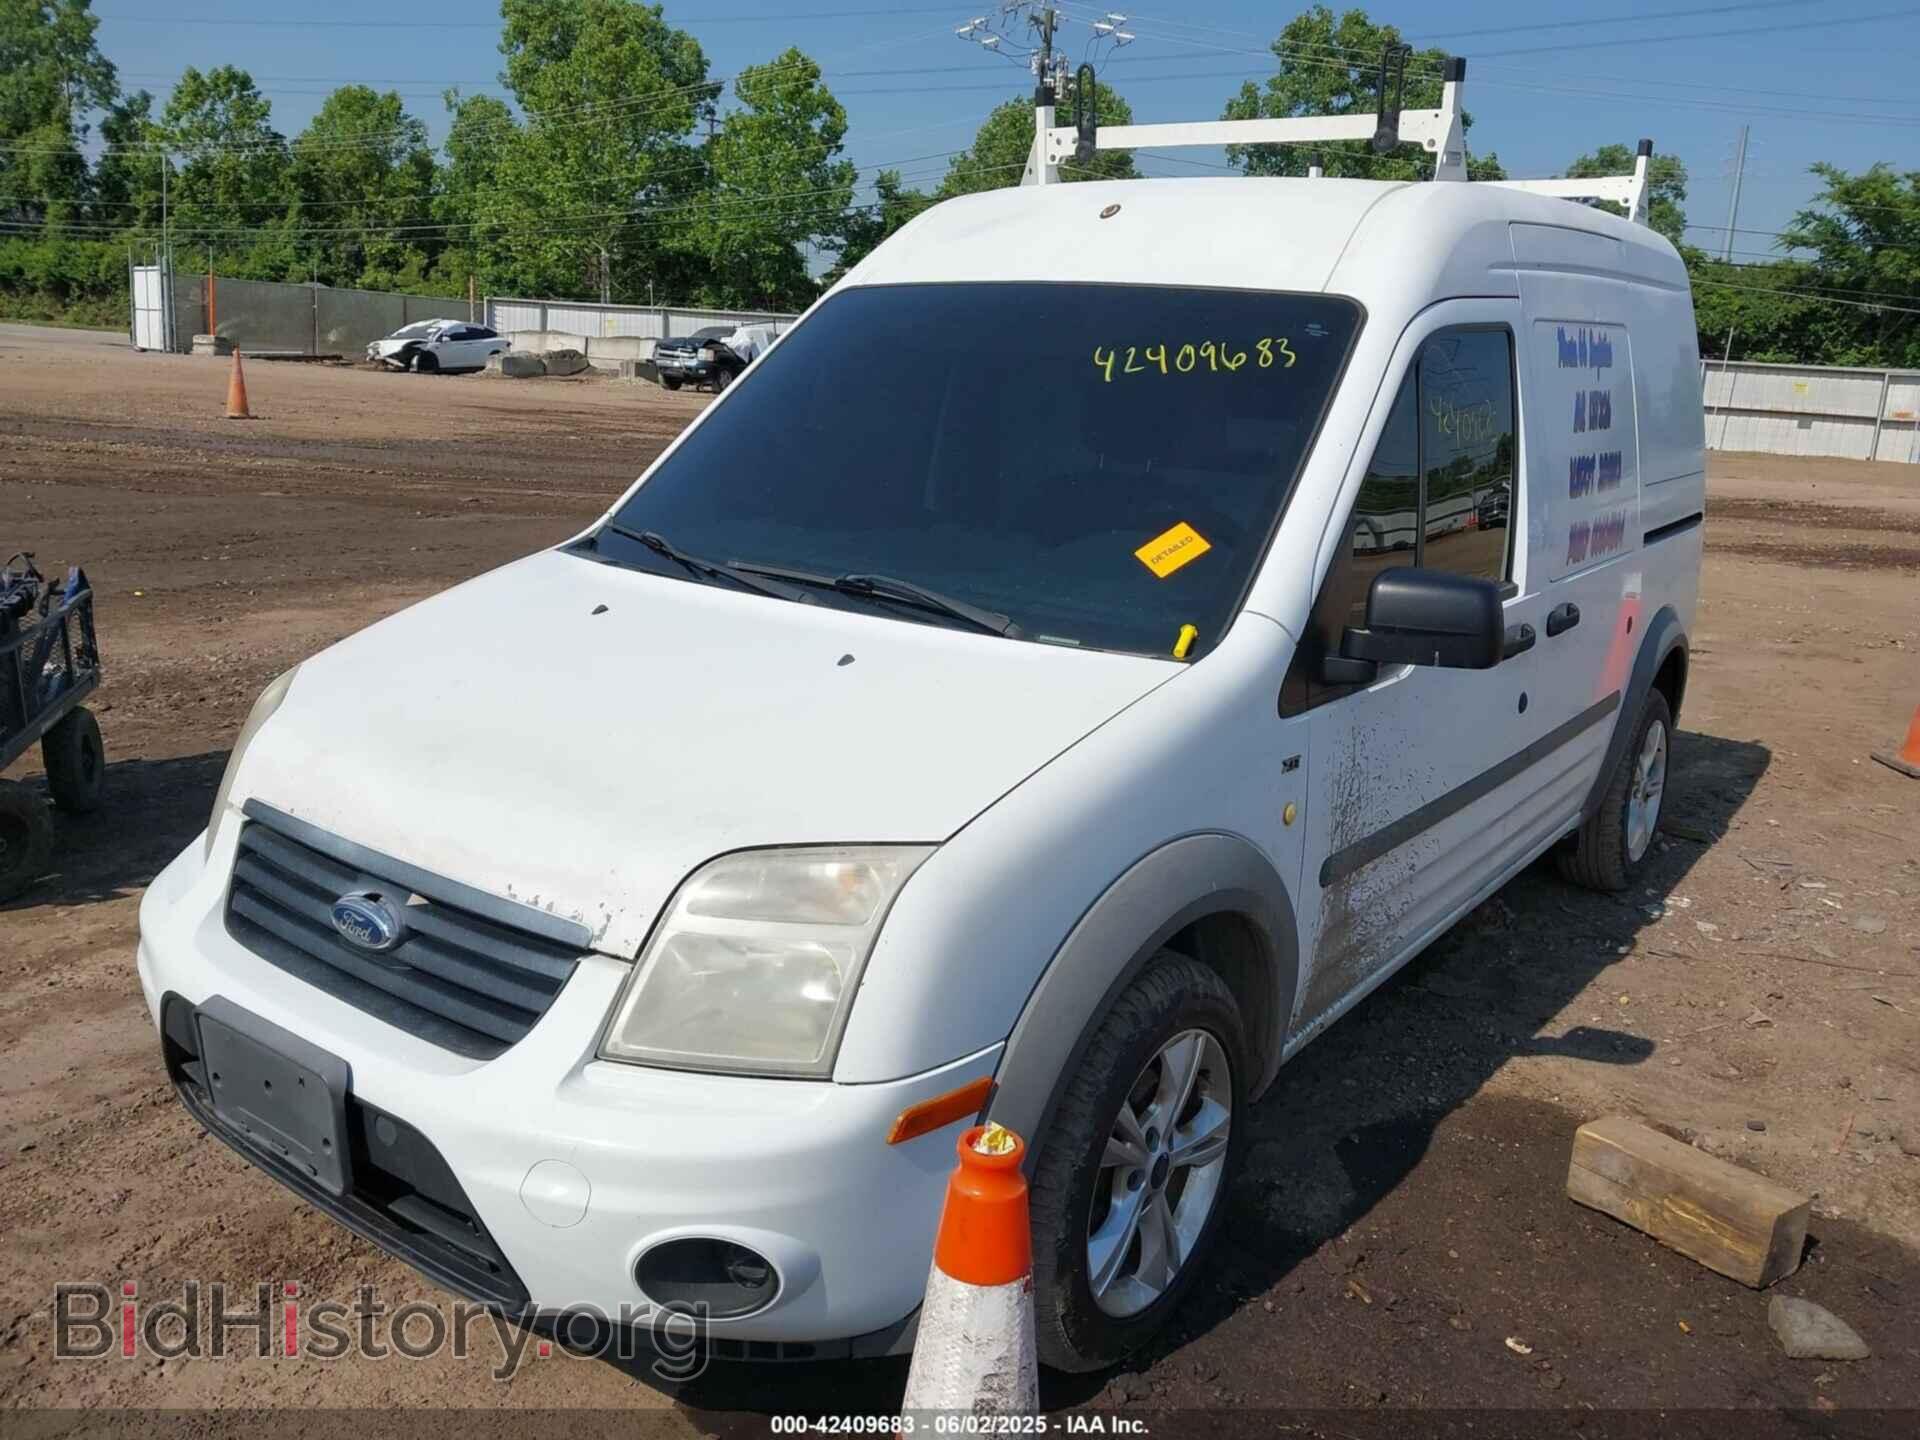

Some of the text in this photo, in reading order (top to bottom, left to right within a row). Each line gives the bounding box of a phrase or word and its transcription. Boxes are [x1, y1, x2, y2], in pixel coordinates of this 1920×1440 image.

[1093, 338, 1297, 383] 42409683
[1151, 535, 1193, 565] DETAILED
[339, 911, 372, 942] Ford
